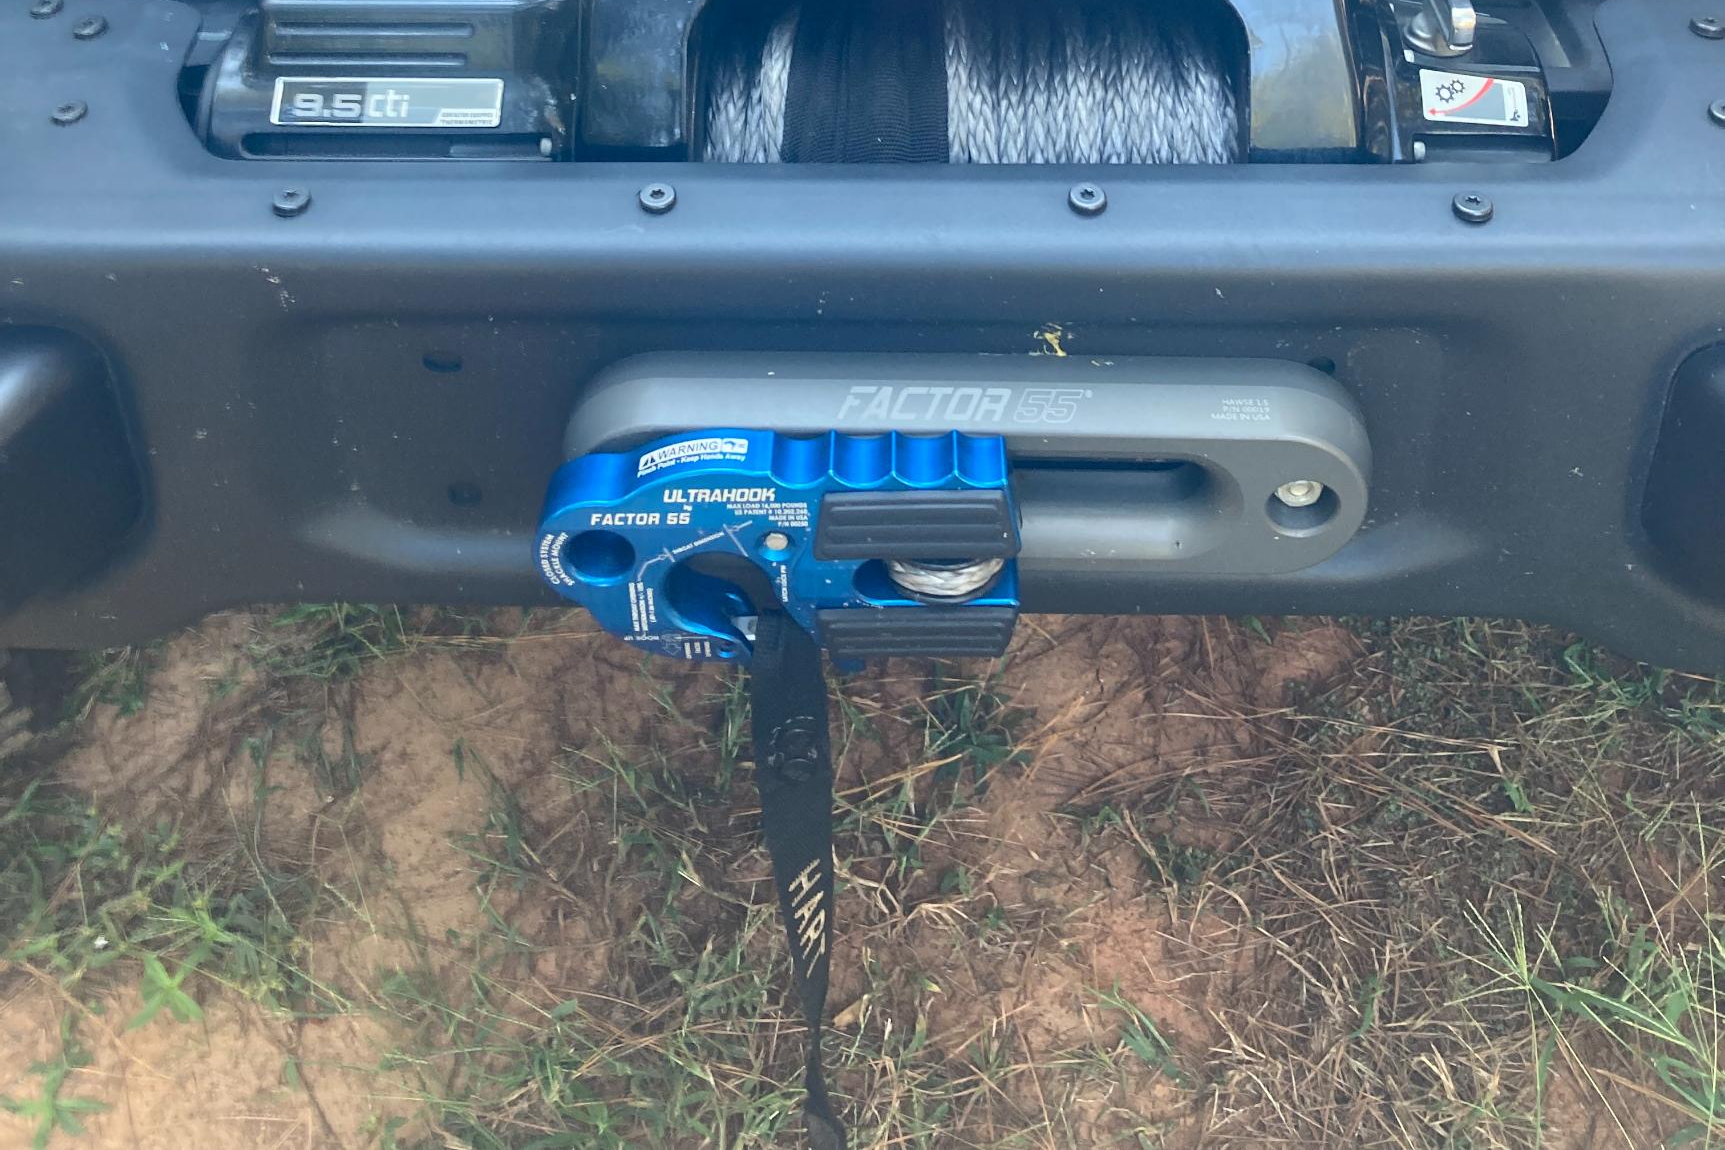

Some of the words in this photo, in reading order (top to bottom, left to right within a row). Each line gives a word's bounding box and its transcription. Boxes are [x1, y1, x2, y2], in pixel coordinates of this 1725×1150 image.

[837, 385, 1012, 422] FACTOR
[1251, 413, 1271, 421] USA
[657, 441, 719, 460] WARNING
[680, 455, 700, 463] Keep
[700, 453, 724, 461] Hands
[725, 453, 746, 462] Away
[663, 487, 776, 503] ULTRAHOOK
[590, 512, 660, 526] FACTOR
[666, 512, 691, 525] 55
[540, 534, 555, 559] SYSTEM
[551, 532, 568, 557] MOUNT
[541, 559, 561, 585] CLOSED
[551, 557, 575, 587] SHACKLE
